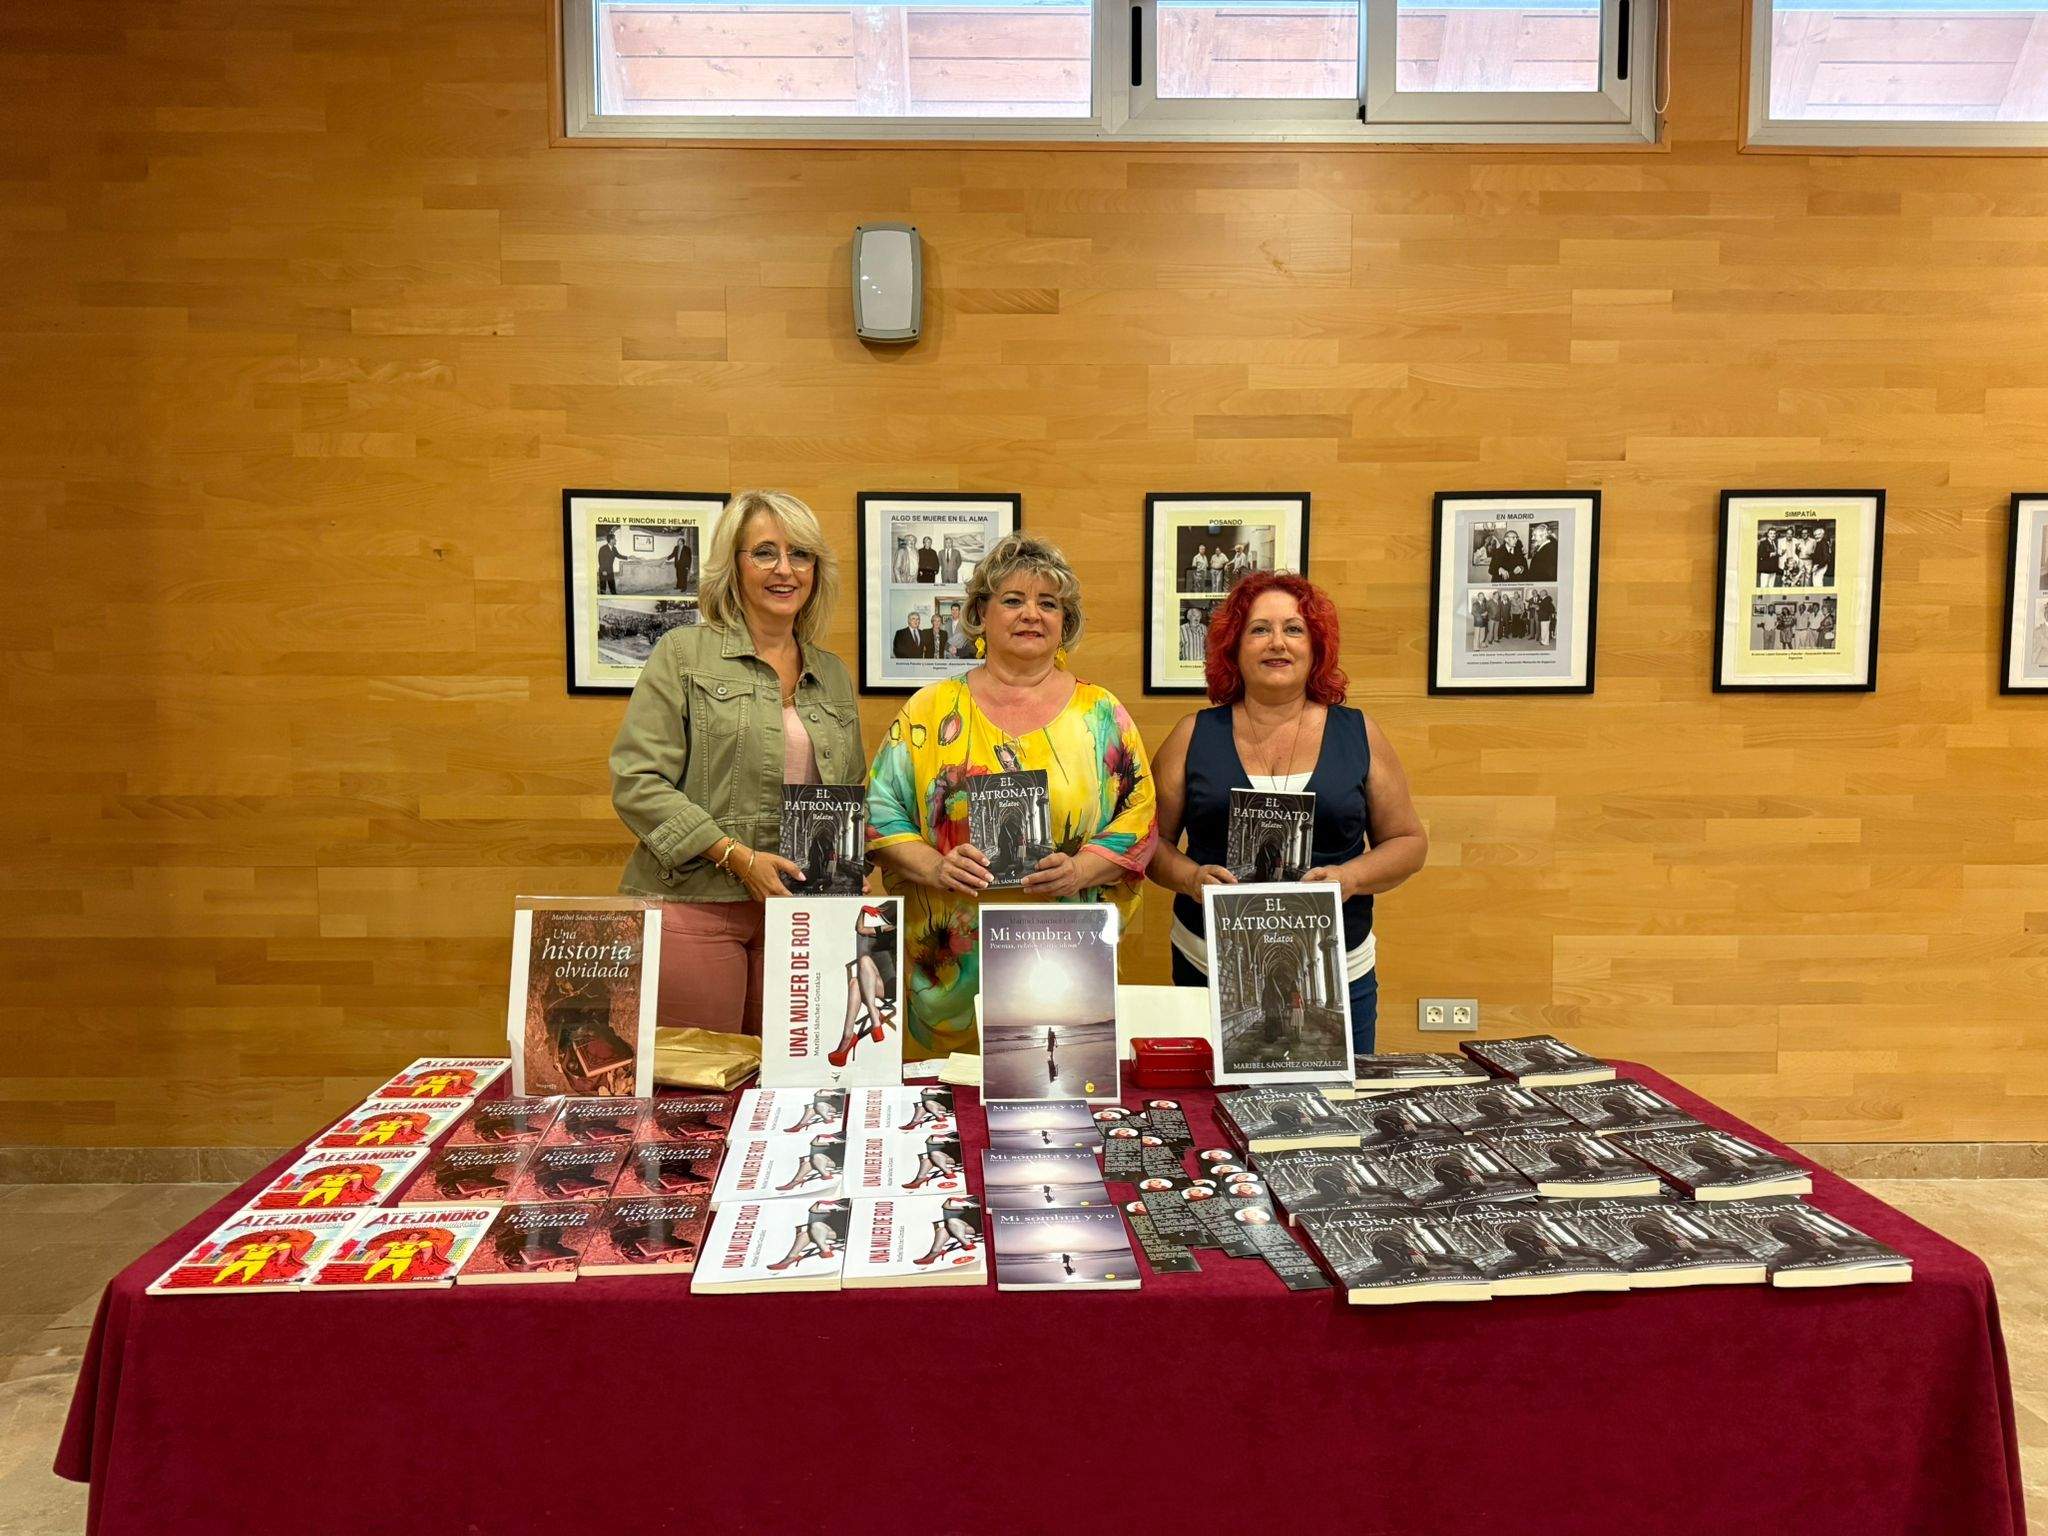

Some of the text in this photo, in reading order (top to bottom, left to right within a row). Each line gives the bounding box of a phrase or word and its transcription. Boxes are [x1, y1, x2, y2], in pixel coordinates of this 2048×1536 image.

[597, 516, 620, 524] CALLE
[629, 516, 655, 524] RINCÓN
[1785, 510, 1816, 518] SIMPATÍA
[1000, 777, 1014, 787] EL
[816, 789, 830, 799] EL
[971, 786, 1045, 801] PATRONATO
[784, 800, 861, 812] PATRONATO
[1265, 798, 1280, 807] EL
[1233, 808, 1309, 820] PATRONATO
[1265, 898, 1286, 912] EL
[552, 913, 574, 921] Maribel
[575, 913, 598, 921] Sánchez
[1222, 915, 1331, 931] PATRONATO
[553, 929, 577, 940] Una
[990, 927, 1010, 941] Mi
[1015, 927, 1072, 941] sombra
[1077, 931, 1085, 944] y
[1263, 932, 1293, 943] Relatos
[542, 938, 633, 961] historia
[555, 961, 629, 978] olvidada
[789, 912, 810, 1057] UNA MUJER DE ROJO
[414, 1060, 504, 1069] ALEJANDRO
[1233, 1059, 1342, 1070] MARIBEL SÁNCHEZ GONZÁLEZ
[360, 1102, 462, 1112] ALEJANDRO
[1489, 1131, 1592, 1143] PATRONATO
[1622, 1130, 1723, 1147] PATRONATO
[1413, 1140, 1435, 1149] EL
[302, 1150, 417, 1165] ALEJANDRO
[1378, 1142, 1481, 1162] PATRONATO
[1260, 1154, 1365, 1167] PATRONATO
[615, 1204, 697, 1216] historia
[1476, 1203, 1501, 1212] EL
[1599, 1200, 1625, 1208] EL
[1730, 1201, 1755, 1209] EL
[1562, 1204, 1678, 1218] PATRONATO
[1693, 1204, 1810, 1217] PATRONATO
[224, 1212, 356, 1231] ALEJANDRO
[362, 1210, 490, 1228] ALEJANDRO
[505, 1211, 590, 1223] historia
[625, 1212, 694, 1222] olvidada
[1438, 1210, 1554, 1224] PATRONATO
[514, 1220, 584, 1229] olvidada
[1311, 1217, 1428, 1230] PATRONATO
